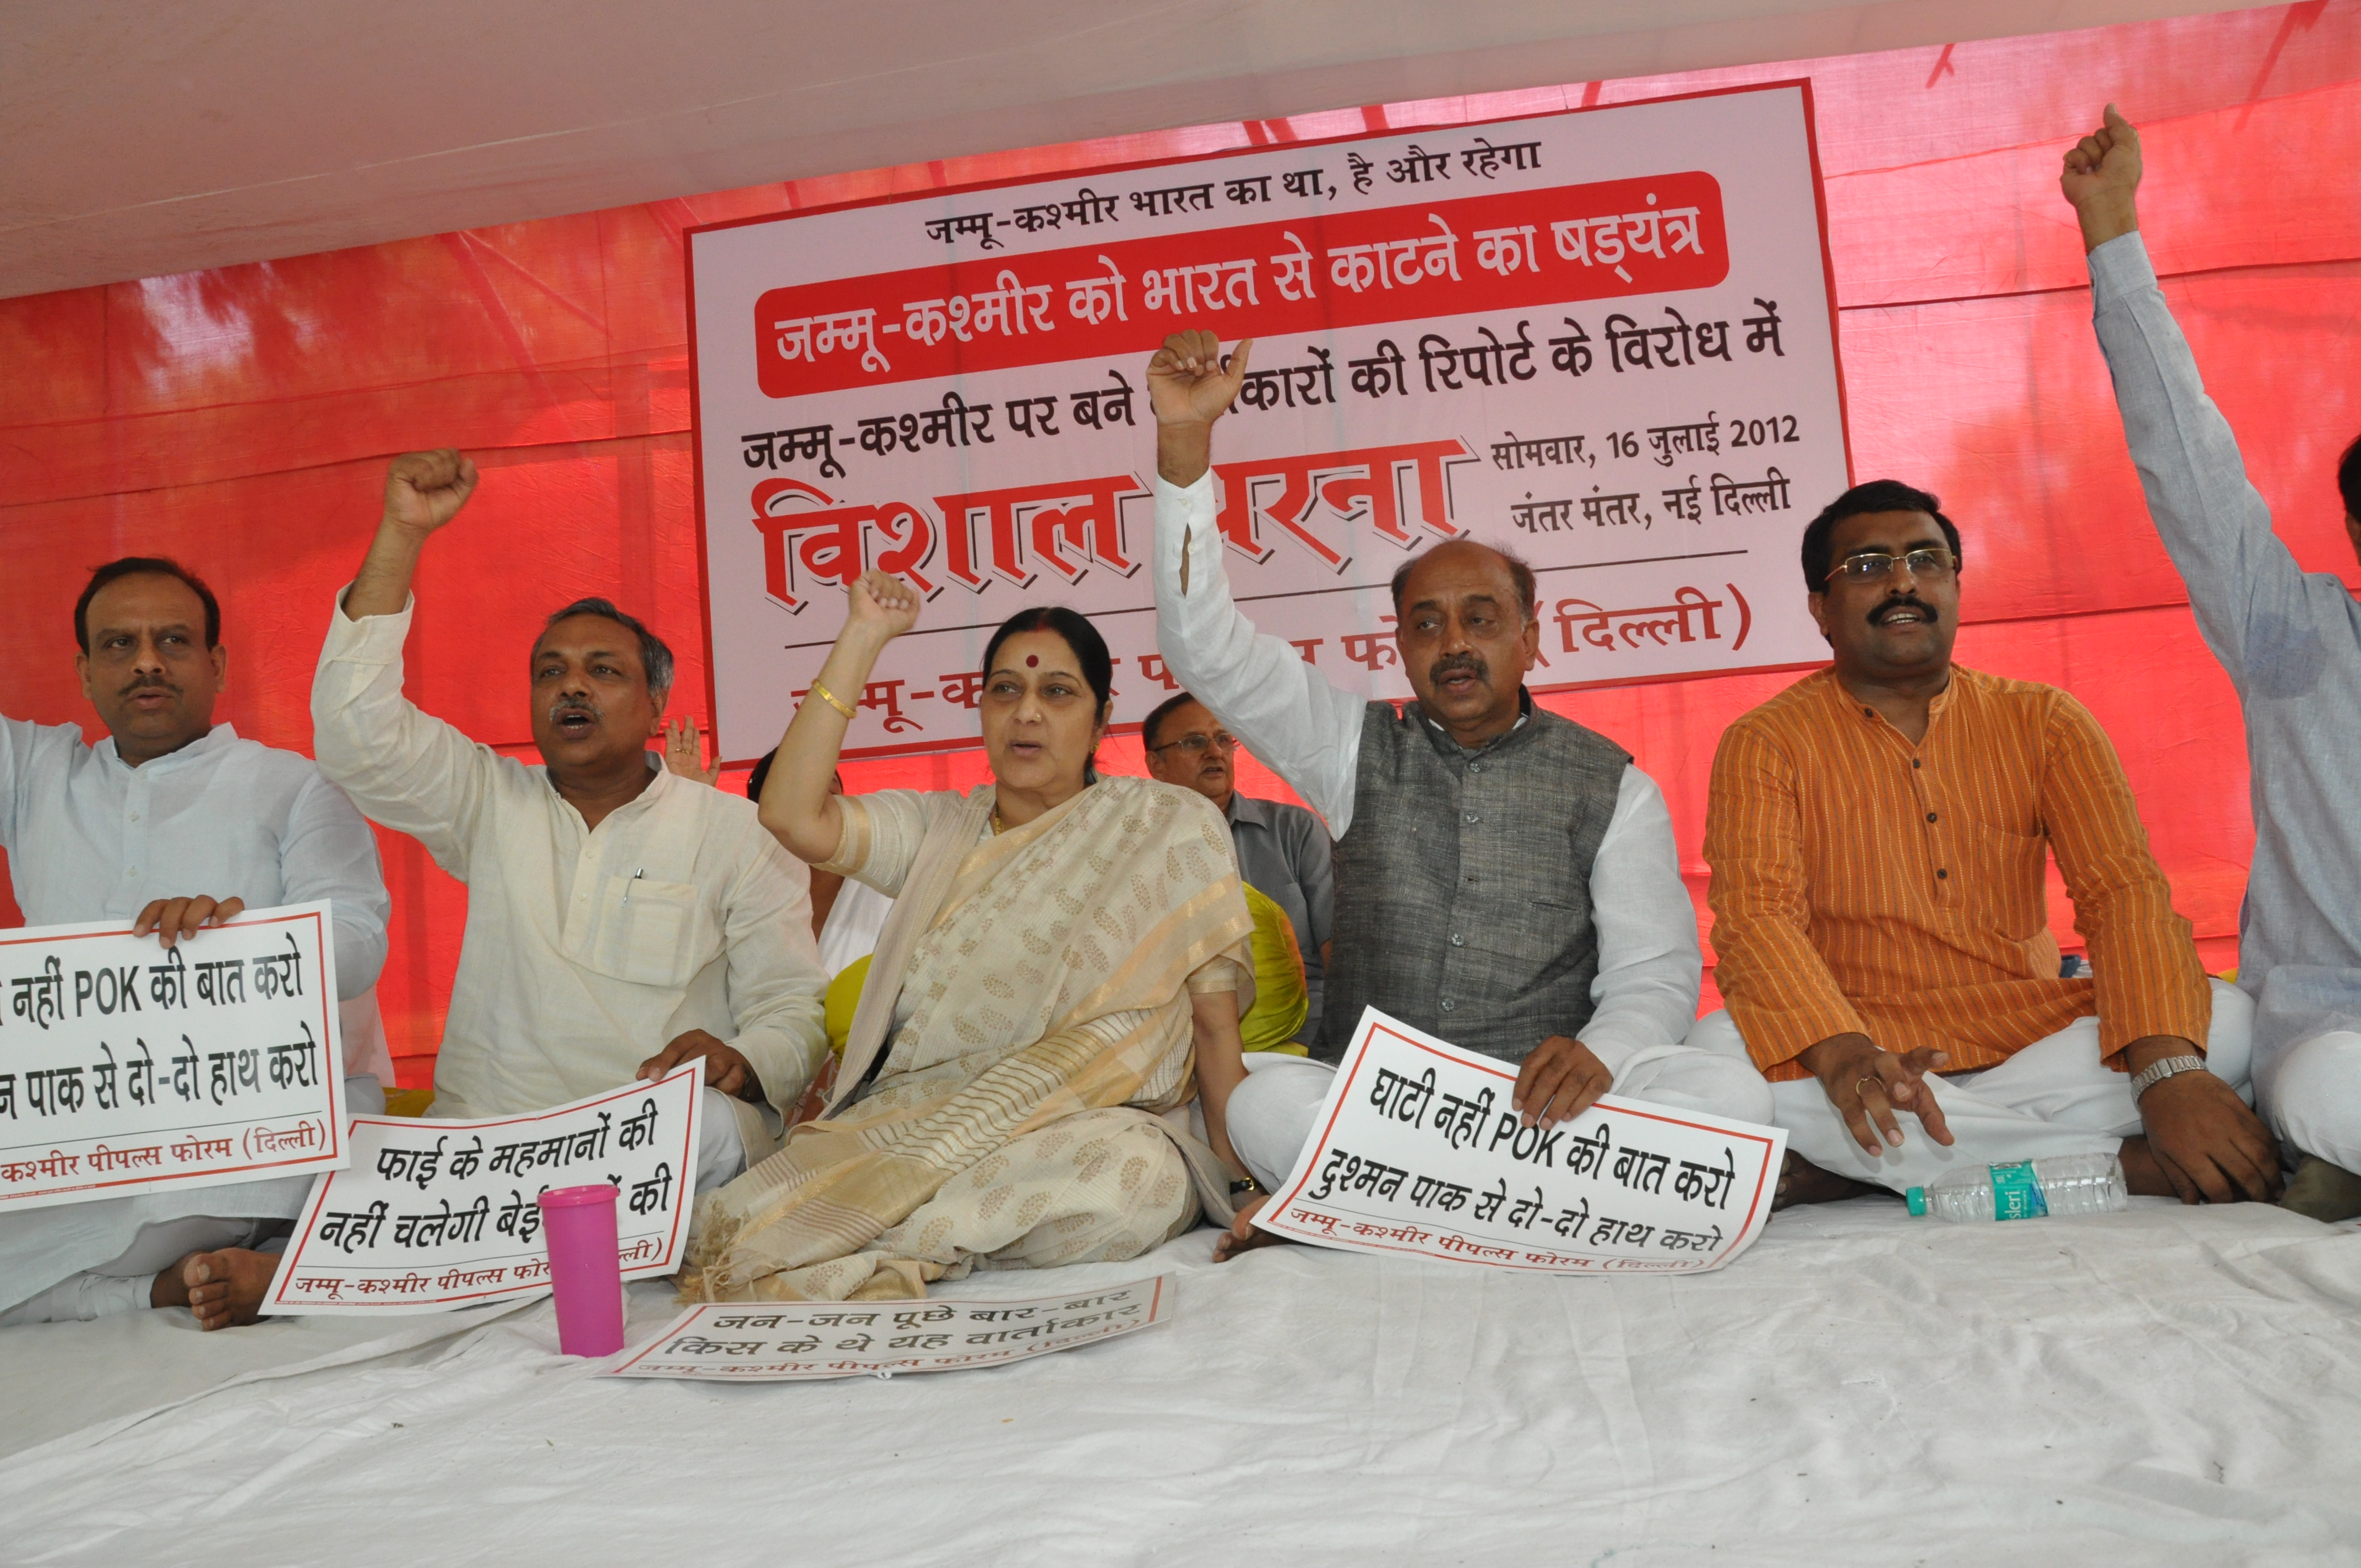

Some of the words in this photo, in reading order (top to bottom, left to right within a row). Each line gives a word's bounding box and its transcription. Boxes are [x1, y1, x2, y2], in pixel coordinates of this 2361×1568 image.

[925, 188, 1119, 250] जम्मू-कश्मीर
[1129, 183, 1215, 216] भारत
[1225, 176, 1271, 205] का
[1282, 169, 1336, 200] था,
[1347, 153, 1374, 195] है
[1386, 145, 1450, 183] और
[1461, 138, 1541, 179] रहेगा
[775, 269, 1055, 372] जम्मू-कश्मीर
[1066, 255, 1128, 325] को
[1143, 259, 1259, 314] भारत
[1270, 231, 1316, 301] से
[1328, 214, 1462, 292] काटने
[1473, 225, 1540, 275] का
[1551, 193, 1704, 283] षड्यंत्र
[741, 391, 995, 478] जम्मू-कश्मीर
[1005, 396, 1059, 438] पर
[1070, 369, 1136, 429] बने
[1348, 340, 1408, 398] की
[1419, 320, 1537, 392] रिपोर्ट
[1548, 317, 1592, 377] के
[1605, 307, 1732, 372] विरोध
[1743, 298, 1785, 356] में
[1490, 431, 1595, 470] सोमवार,
[1607, 432, 1639, 459] 16
[1647, 411, 1719, 467] जुलाई
[1731, 415, 1799, 447] 2012
[1511, 492, 1573, 533] जंतर
[1581, 493, 1651, 530] मंतर,
[1662, 475, 1701, 524] नई
[1710, 466, 1791, 515] दिल्ली
[751, 477, 1156, 616] विशाल
[1533, 583, 1751, 667] (दिल्ली)
[12, 955, 64, 1030] नहीं
[75, 966, 142, 1017] POK
[149, 946, 187, 1009] की
[195, 960, 246, 1006] बात
[253, 932, 303, 999] करो
[26, 1067, 84, 1116] पाक
[93, 1042, 119, 1109] से
[127, 1034, 200, 1106] दो-दो
[208, 1049, 260, 1106] हाथ
[268, 1021, 318, 1089] करो
[88, 1144, 162, 1171] पीपल्स
[170, 1135, 233, 1162] फोरम
[243, 1119, 326, 1160] (दिल्ली)
[377, 1136, 448, 1190] फाई
[450, 1136, 483, 1180] के
[488, 1112, 611, 1177] महमानों
[619, 1098, 658, 1151] की
[1370, 1068, 1435, 1129] घाटी
[1434, 1087, 1495, 1150] नहीं
[1489, 1112, 1566, 1167] POK
[1567, 1124, 1609, 1180] की
[1614, 1147, 1671, 1194] बात
[1675, 1147, 1735, 1210] करो
[320, 1200, 389, 1254] नहीं
[394, 1195, 489, 1248] चलेगी
[629, 1162, 672, 1215] की
[1290, 1210, 1432, 1244] जम्मू-कश्मीर
[1438, 1235, 1519, 1261] पीपल्स
[1526, 1253, 1593, 1268] फोरम
[1603, 1256, 1705, 1271] (दिल्ली)
[1308, 1147, 1408, 1202] दुश्मन
[1411, 1175, 1472, 1211] पाक
[1475, 1178, 1506, 1222] से
[1508, 1186, 1589, 1238] दो-दो
[1590, 1217, 1655, 1247] हाथ
[1660, 1224, 1723, 1251] करो
[2004, 1190, 2021, 1219] sleri
[296, 1272, 432, 1299] जम्मू-कश्मीर
[438, 1268, 507, 1289] पीपल्स
[514, 1257, 551, 1280] फोर
[714, 1314, 881, 1329] जन-जन
[893, 1305, 957, 1330] पूछे
[969, 1291, 1130, 1322] बार-बार
[665, 1337, 766, 1355] किस
[777, 1335, 823, 1353] के
[836, 1333, 875, 1352] थे
[888, 1335, 953, 1349] यह
[966, 1303, 1141, 1346] वार्ताकार
